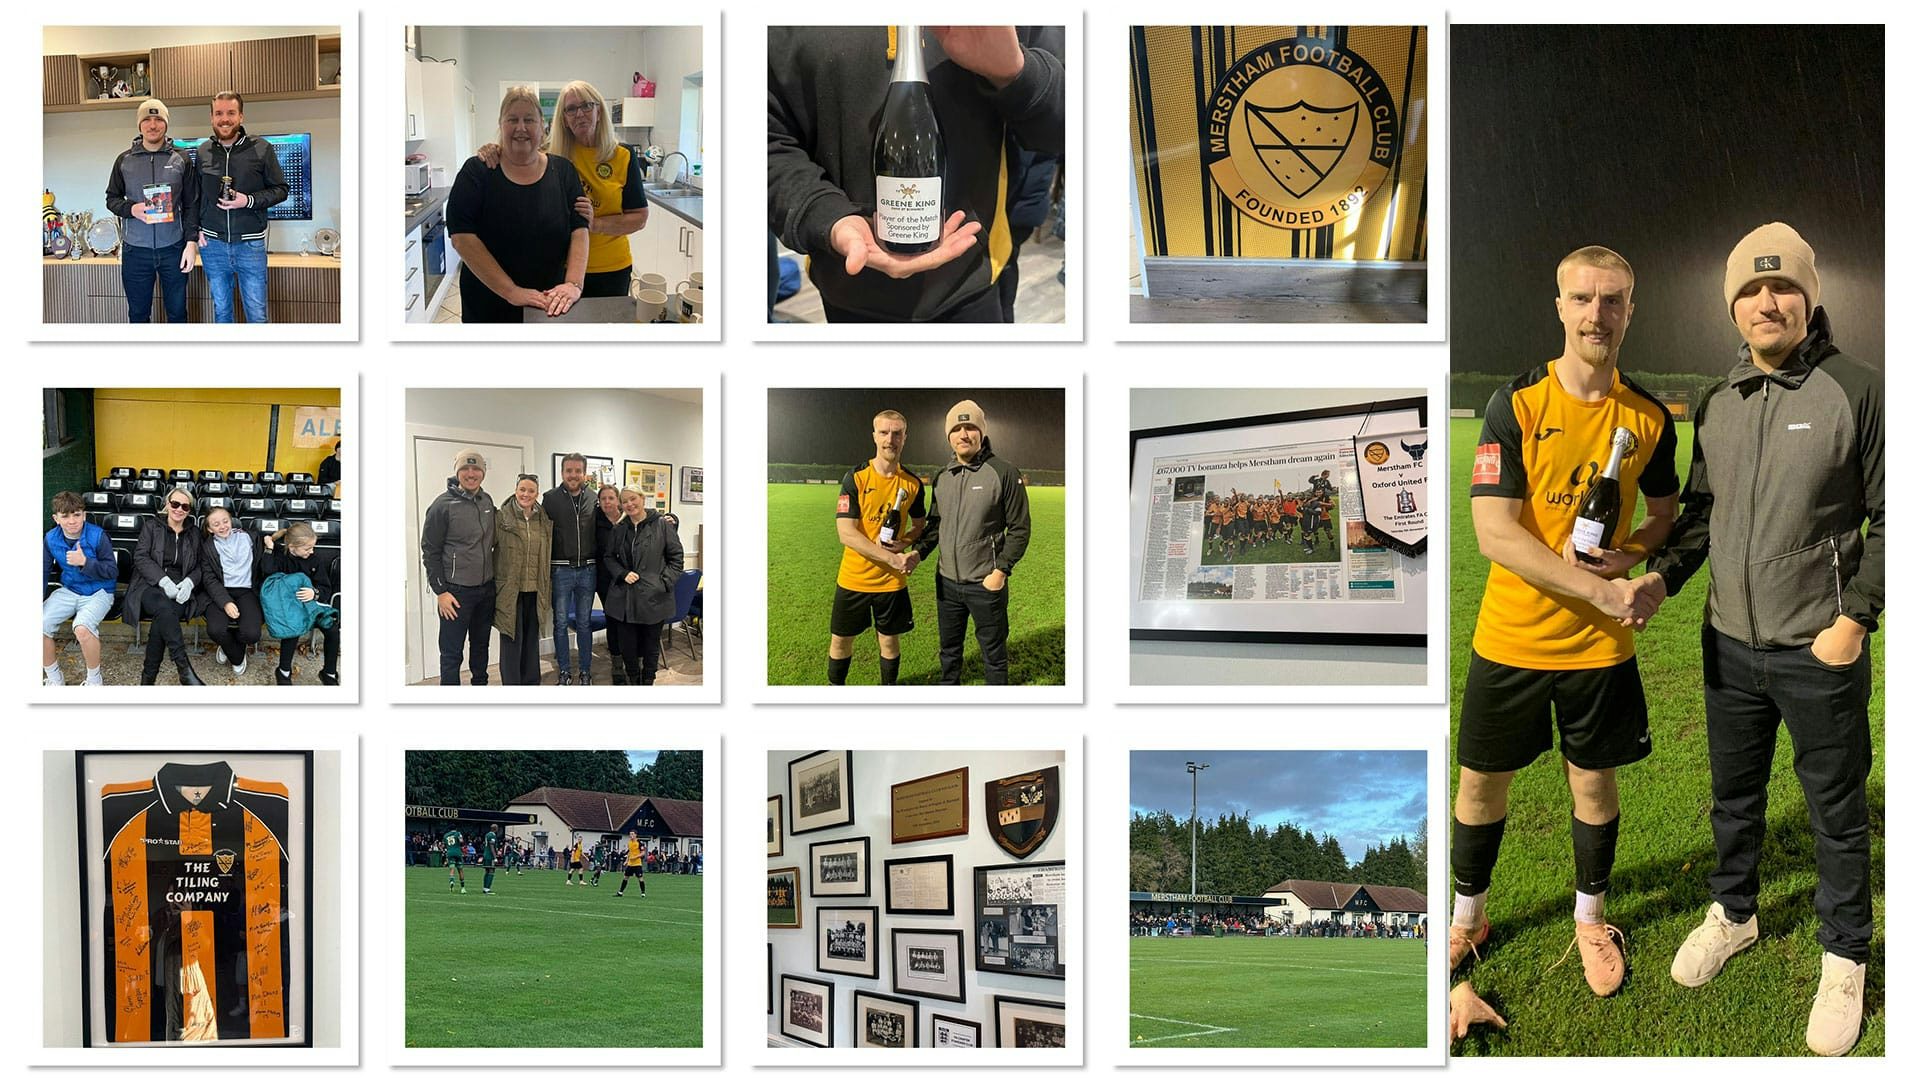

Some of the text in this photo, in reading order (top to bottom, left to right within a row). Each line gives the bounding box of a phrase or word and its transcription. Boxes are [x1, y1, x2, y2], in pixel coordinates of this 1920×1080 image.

[1211, 44, 1393, 160] MERSTHAM FOOTBALL CLUB
[880, 199, 912, 207] GREENE
[1235, 185, 1369, 224] FOUNDED 1892
[886, 222, 930, 231] Sponsored by
[888, 230, 929, 239] Greene King
[1198, 462, 1228, 471] bonanza
[1228, 460, 1248, 470] helps
[1249, 457, 1287, 468] Merstham
[1287, 455, 1313, 465] dream
[1313, 453, 1336, 463] again
[1377, 461, 1424, 473] Merstham FC
[1372, 481, 1396, 489] Oxford
[1398, 478, 1422, 487] United
[438, 807, 459, 819] CLUB
[184, 862, 211, 873] THE
[175, 876, 219, 888] TILING
[165, 891, 230, 903] COMPANY
[1151, 892, 1233, 904] MERSTHAM FOOTBALL CLUB
